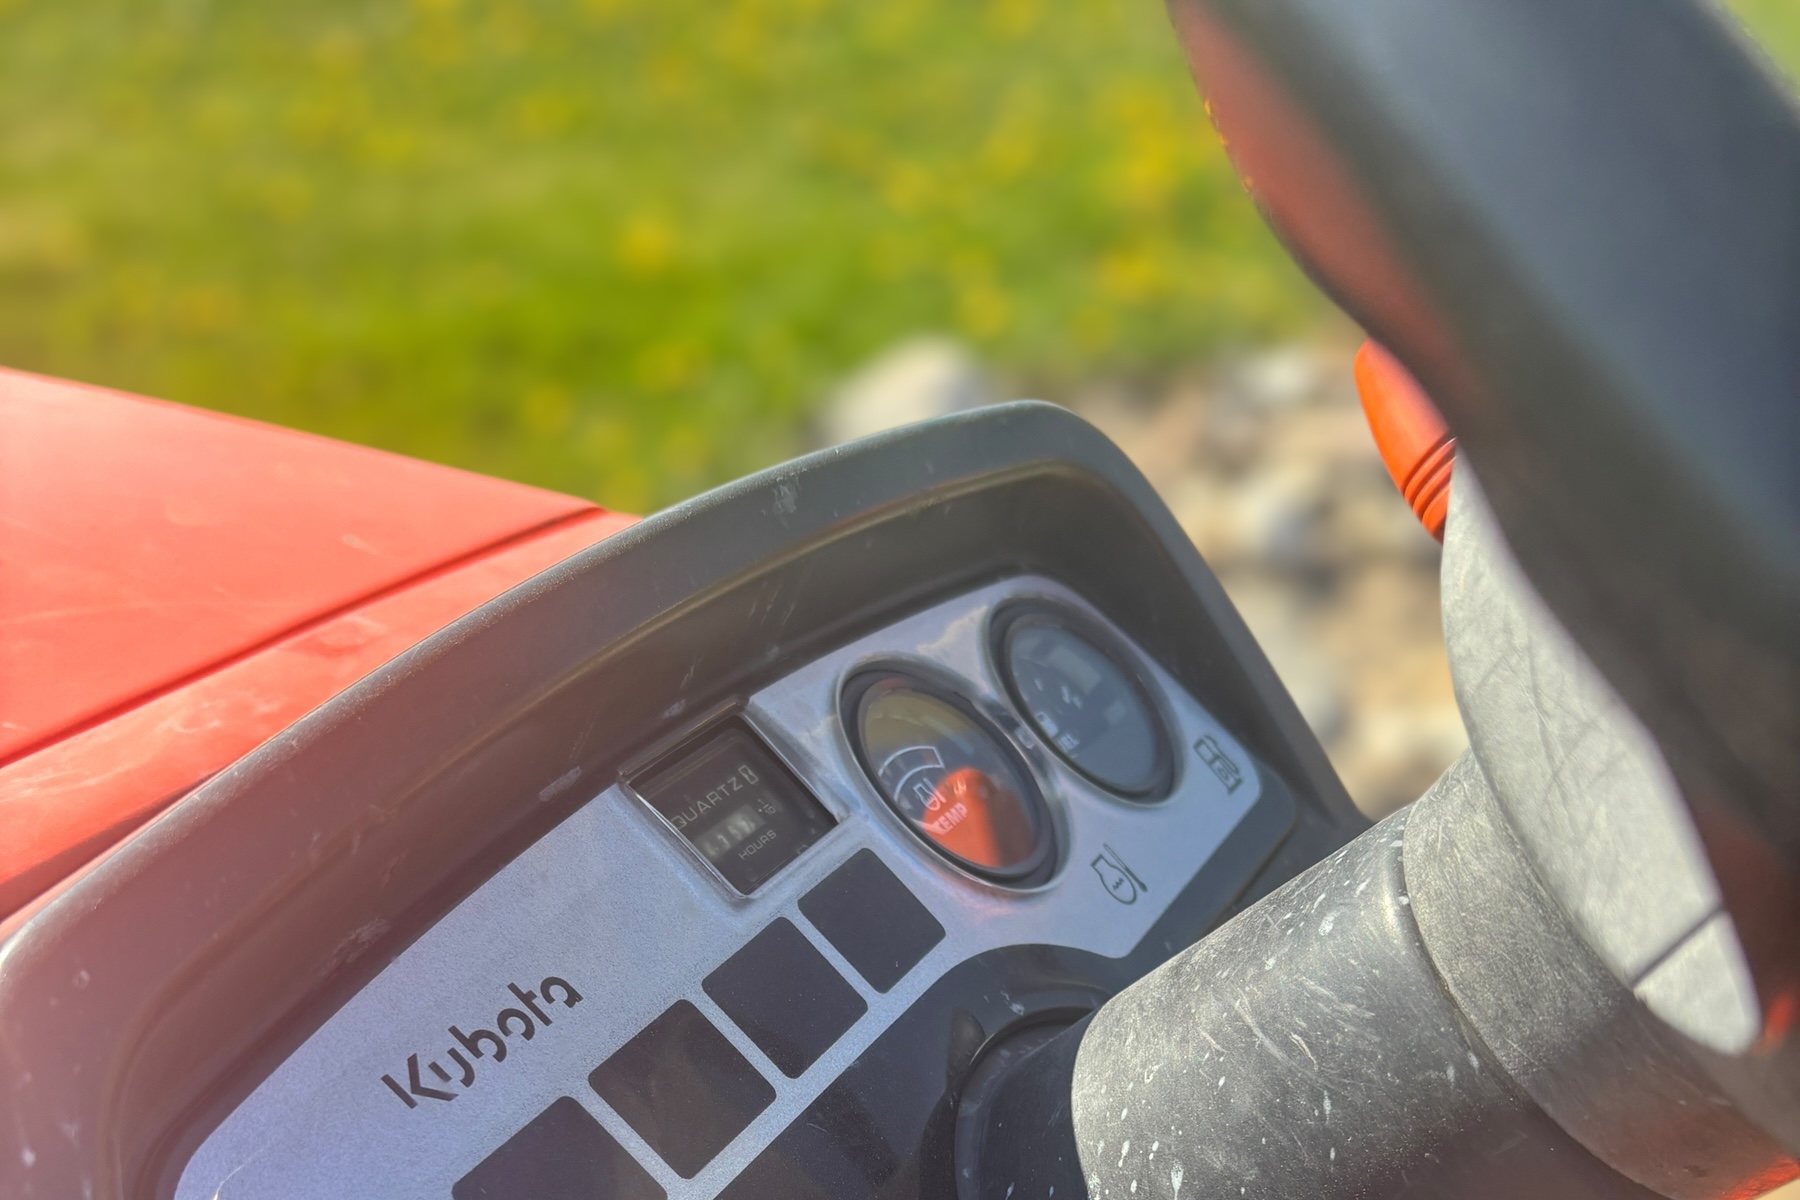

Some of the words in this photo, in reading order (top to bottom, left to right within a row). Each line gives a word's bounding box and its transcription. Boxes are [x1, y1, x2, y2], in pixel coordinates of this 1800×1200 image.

[669, 776, 743, 830] QUARTZ
[738, 829, 777, 861] HOURS
[381, 976, 584, 1109] Kubota
